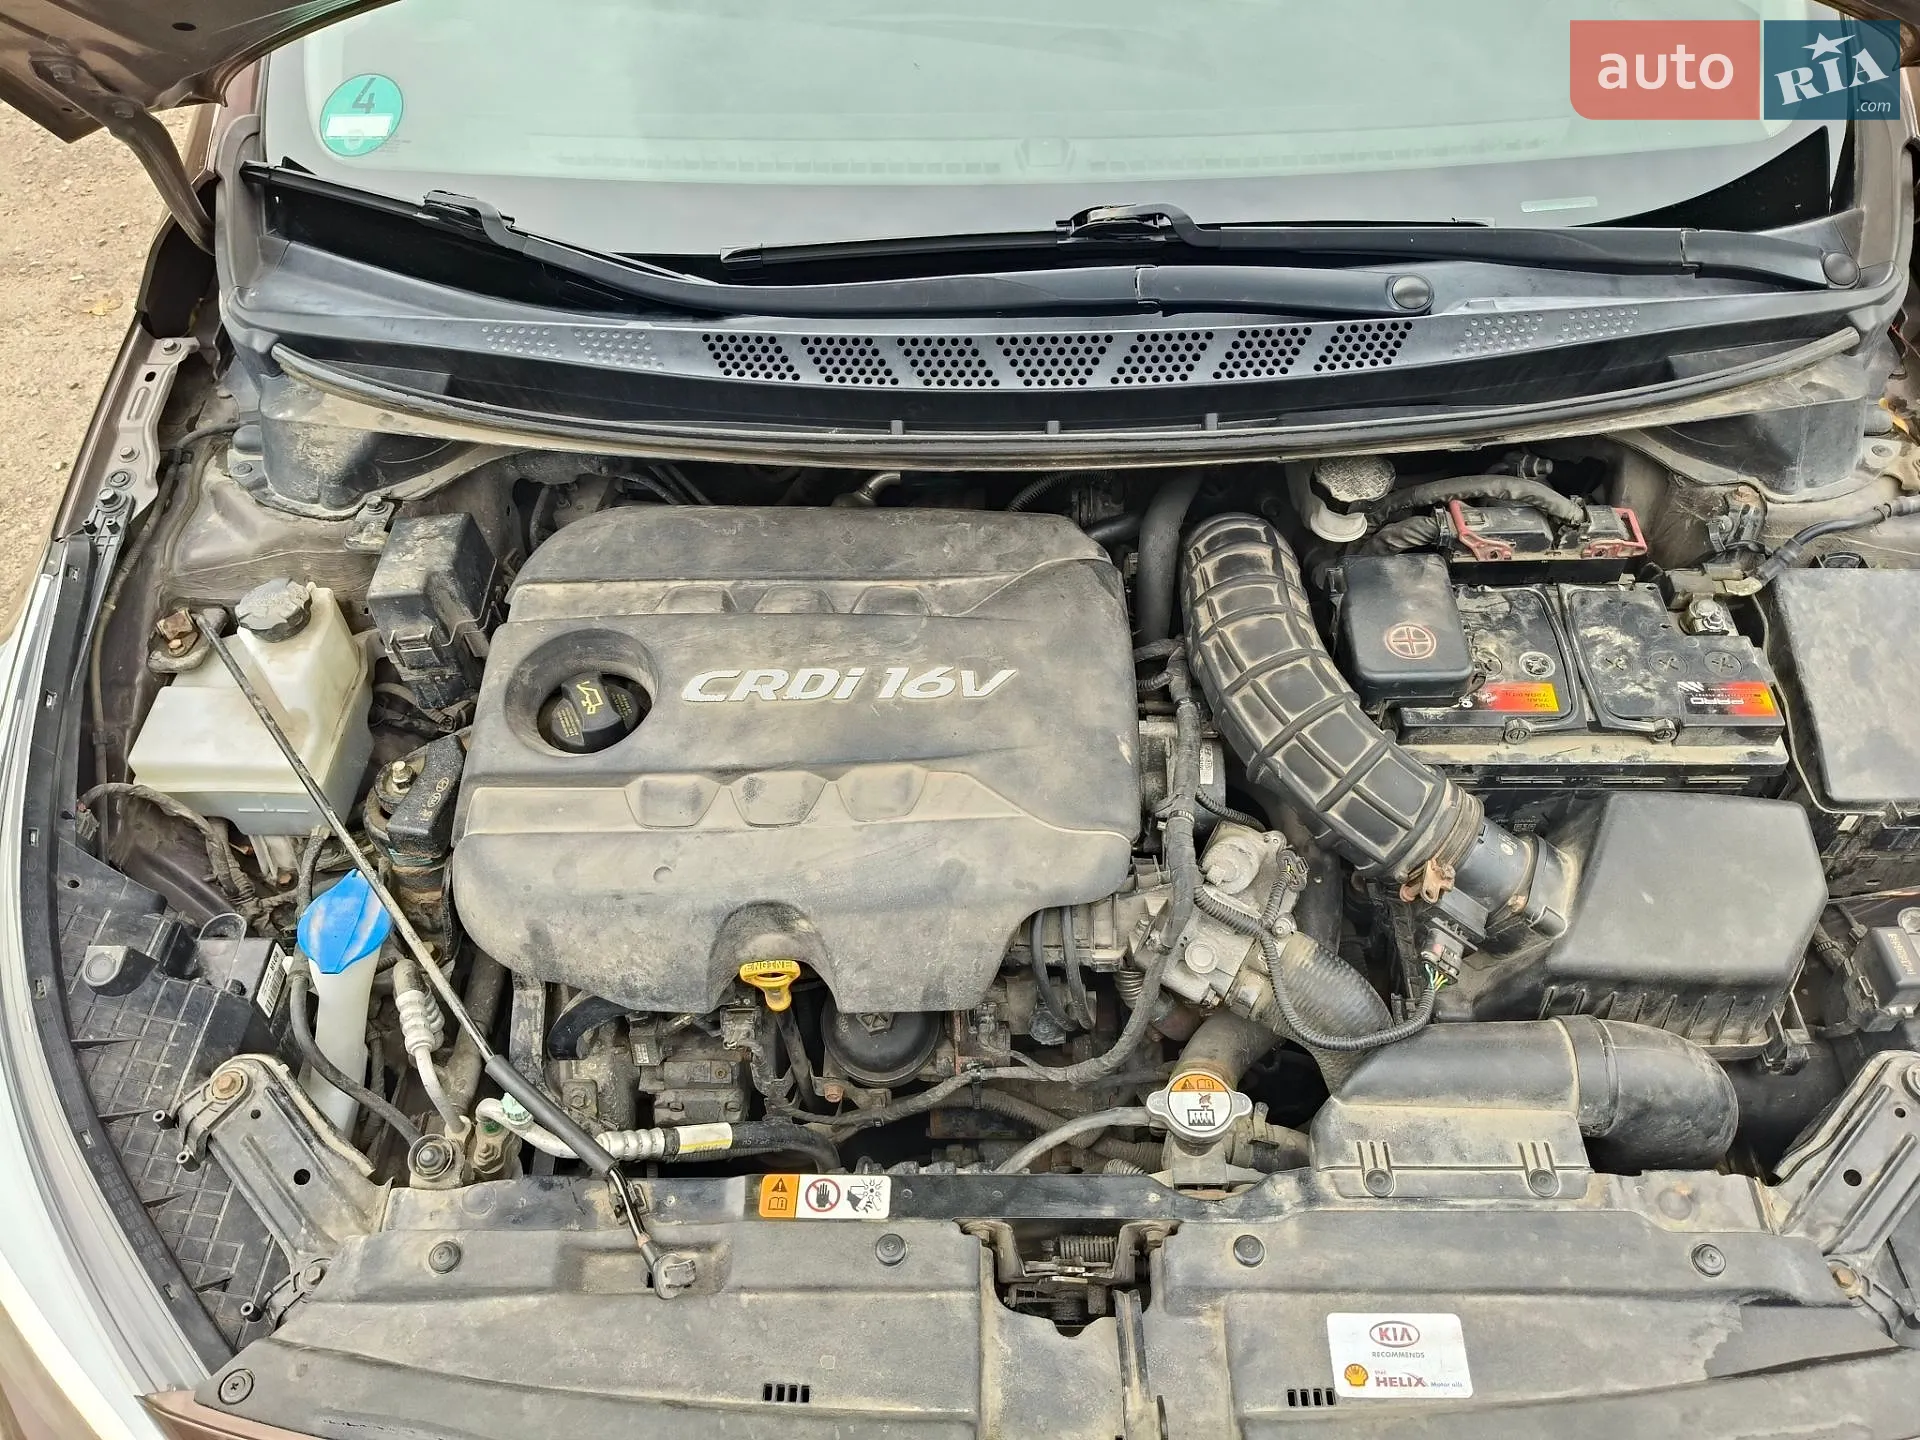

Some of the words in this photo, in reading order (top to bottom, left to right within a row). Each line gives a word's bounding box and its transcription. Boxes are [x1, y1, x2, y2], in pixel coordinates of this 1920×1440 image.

[352, 77, 376, 114] 4
[681, 667, 866, 702] CRDi
[878, 667, 1018, 700] 16V
[745, 960, 793, 972] ENGINE
[1378, 1327, 1413, 1341] KIA
[1371, 1351, 1425, 1359] RECOMMENDS
[1375, 1376, 1427, 1387] HELIX
